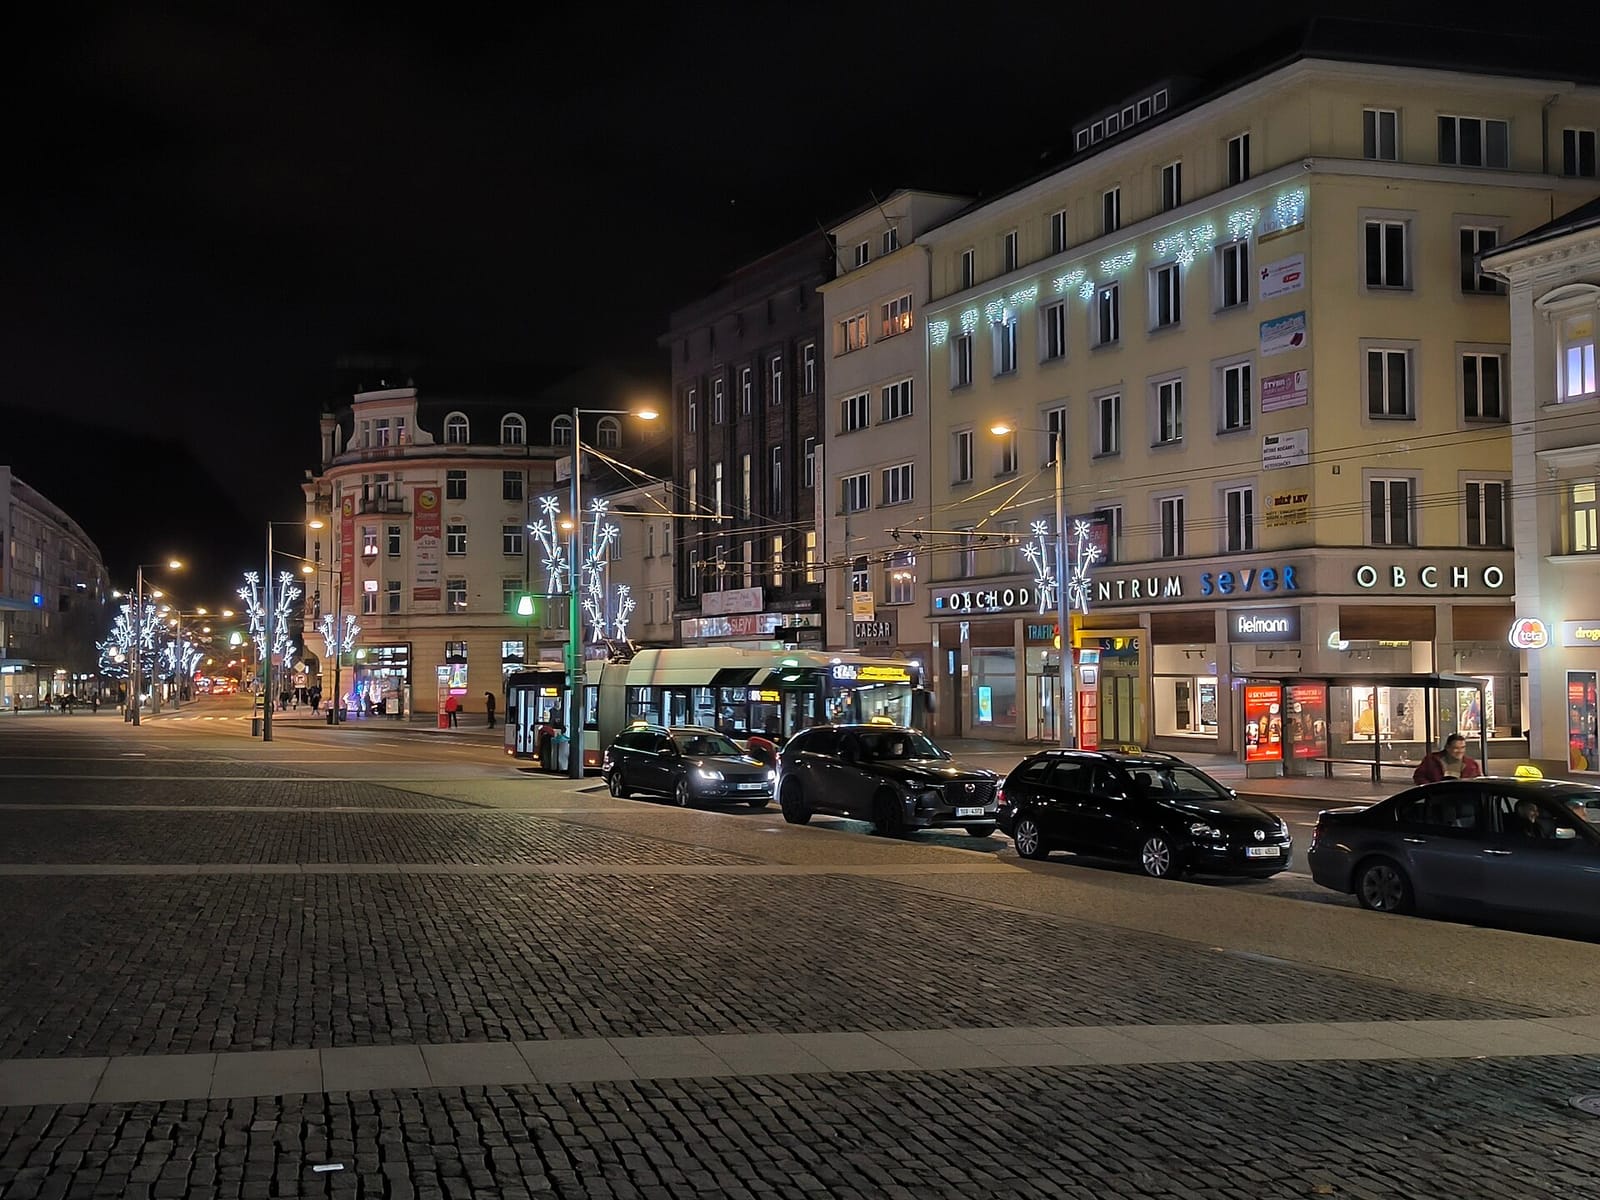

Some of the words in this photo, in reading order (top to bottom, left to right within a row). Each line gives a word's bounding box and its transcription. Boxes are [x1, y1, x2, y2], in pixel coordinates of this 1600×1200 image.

[1356, 565, 1504, 588] OBCHO
[855, 622, 891, 638] CAESAR
[1520, 629, 1543, 641] teta
